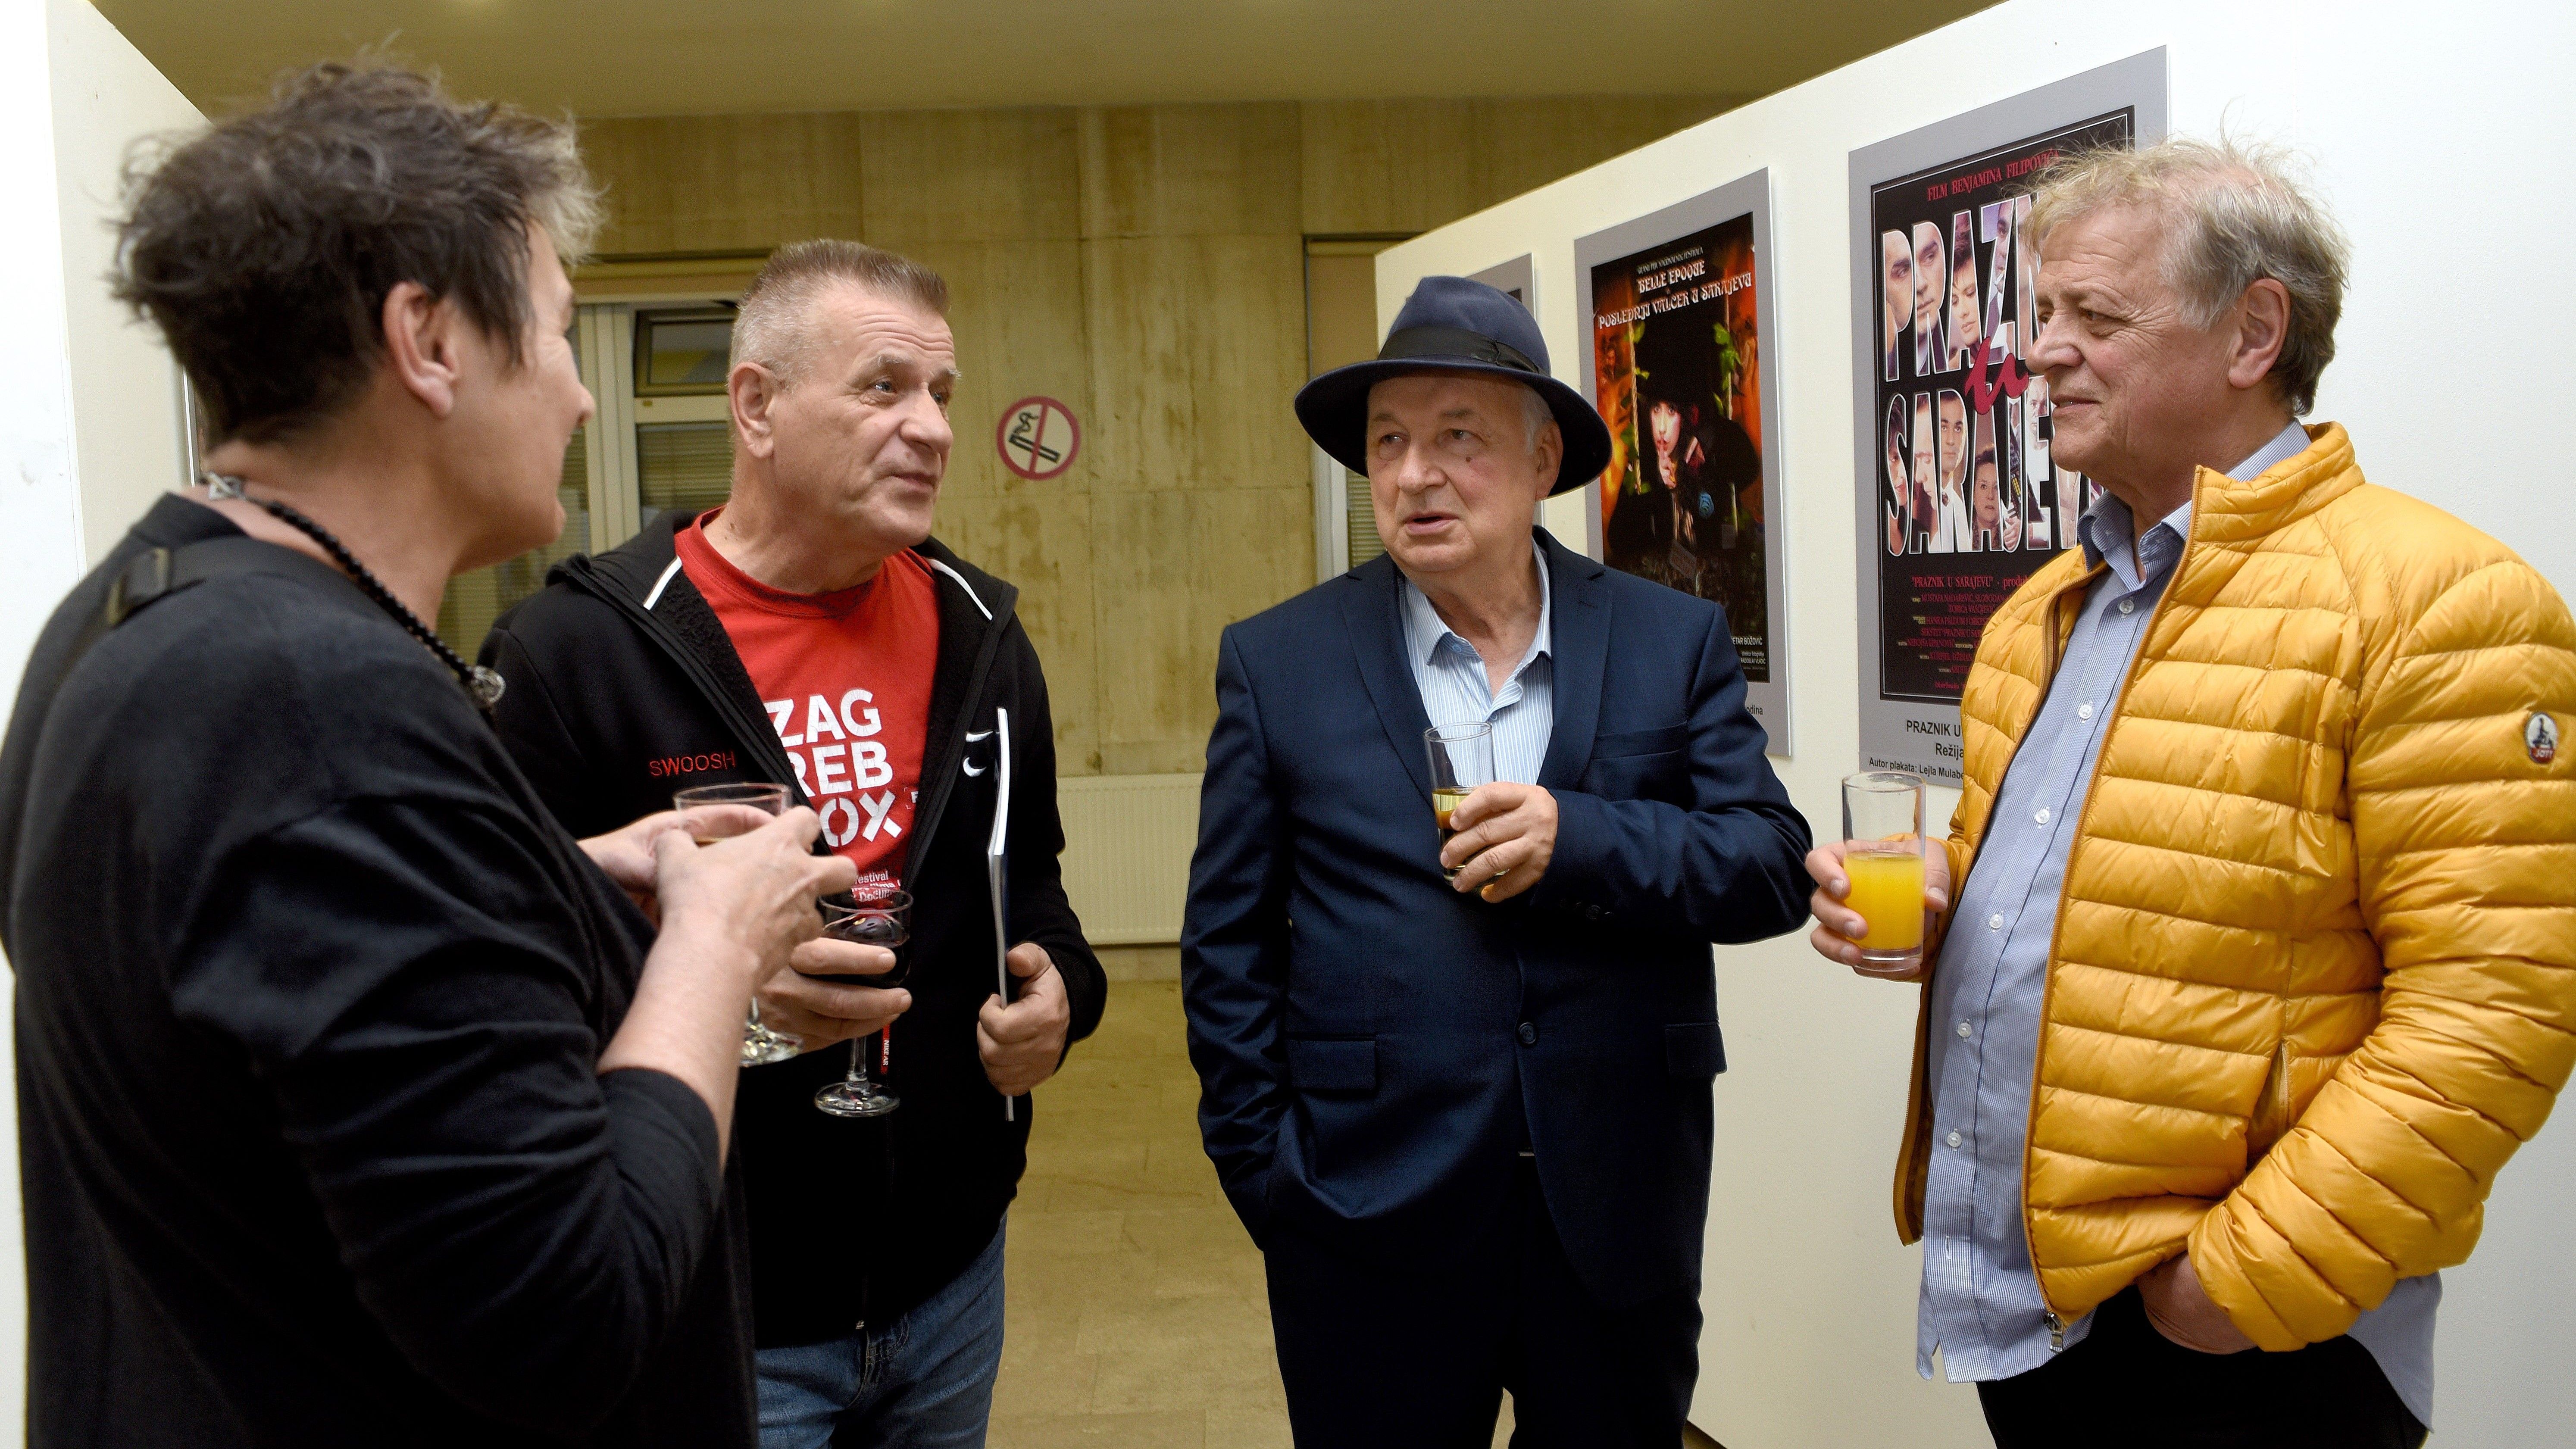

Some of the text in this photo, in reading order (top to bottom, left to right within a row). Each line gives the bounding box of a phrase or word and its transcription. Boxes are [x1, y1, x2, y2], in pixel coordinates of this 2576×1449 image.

[1927, 183, 1948, 201] FILM
[1952, 168, 2002, 194] BENJAMINA
[1638, 272, 1667, 294] BELLE
[1668, 259, 1706, 284] EPOQUE
[1882, 194, 2046, 382] PRAZN
[1652, 292, 1690, 314] VALCER
[1691, 288, 1699, 304] U
[1701, 272, 1752, 301] SARAJEVU
[1885, 375, 2105, 557] SARAJEV
[1947, 577, 1952, 587] U
[1744, 636, 1763, 646] BOŽOVIĆ
[764, 689, 882, 747] ZAG
[1747, 705, 1763, 715] odina
[1906, 720, 1961, 737] PRAZNIK U
[649, 751, 736, 777] SWOOSH
[1935, 743, 1964, 761] Režija
[787, 740, 893, 797] REB
[1869, 757, 1964, 780] Autor plakata: Lejla Mulabe
[819, 790, 902, 847] OX
[855, 870, 889, 884] estival
